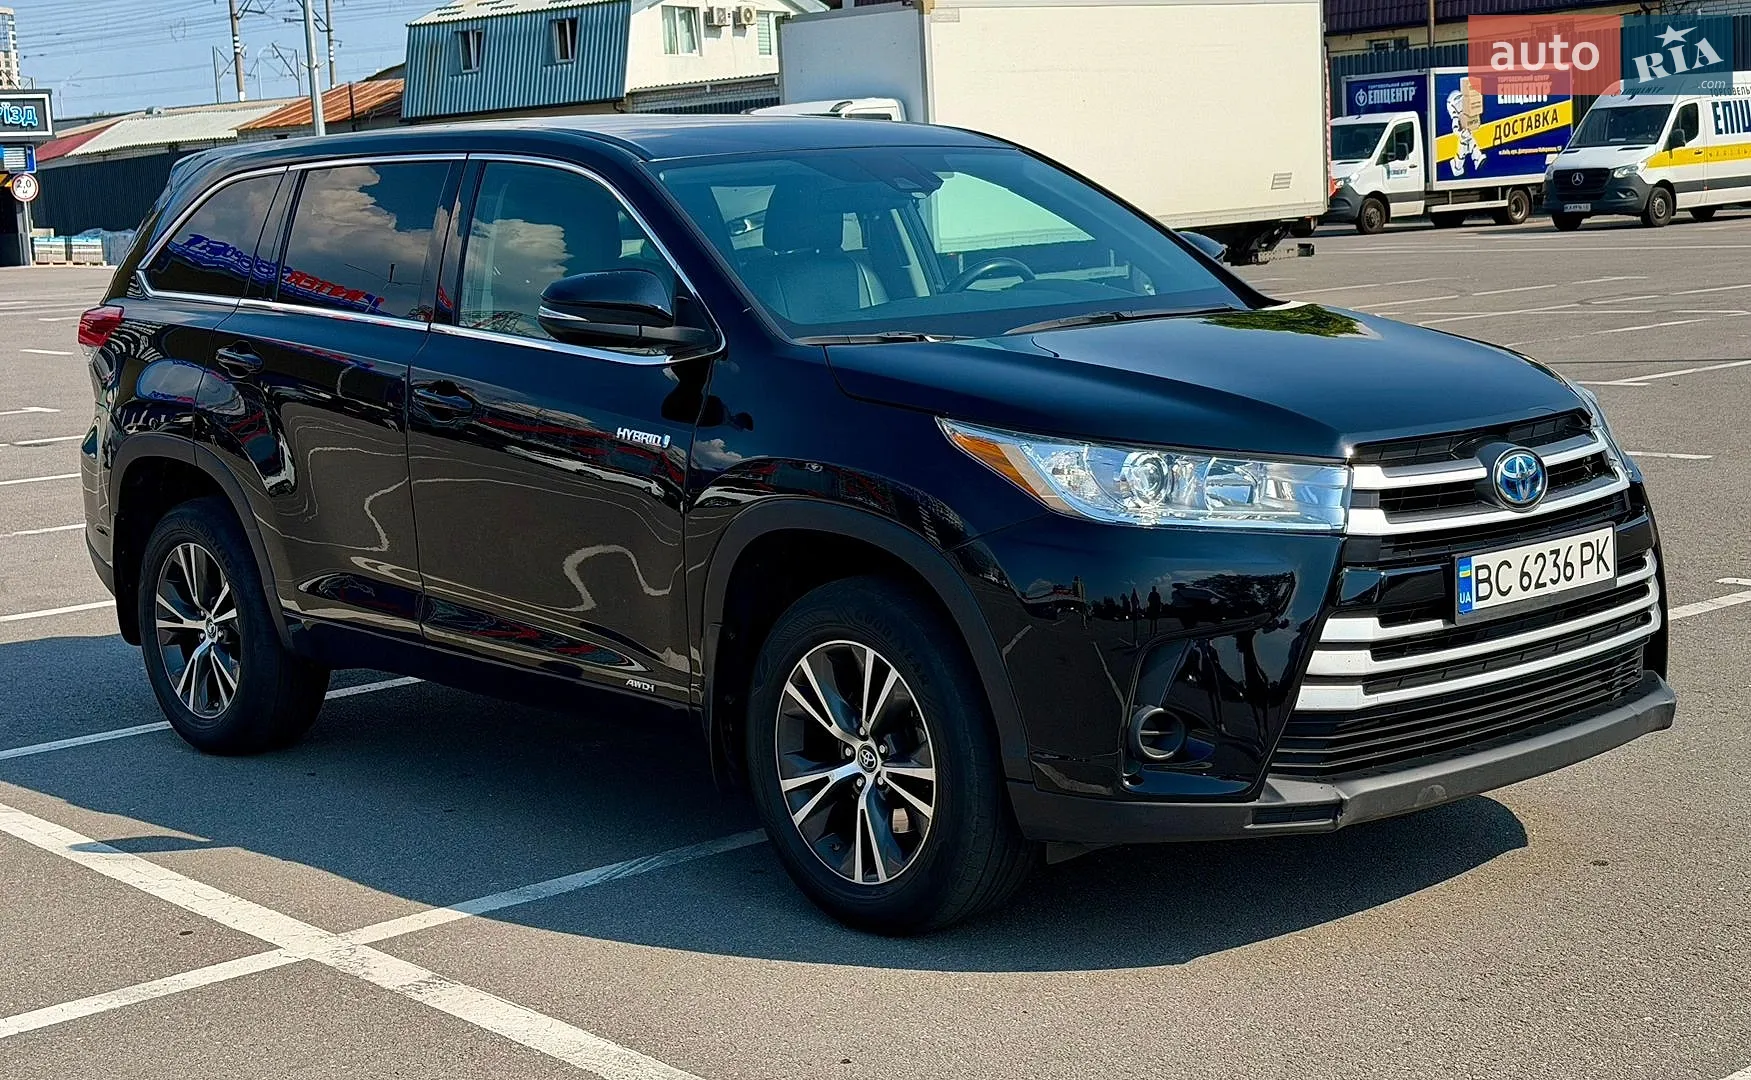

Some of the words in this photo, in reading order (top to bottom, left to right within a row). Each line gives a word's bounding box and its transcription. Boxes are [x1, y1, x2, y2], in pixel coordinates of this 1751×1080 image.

[1710, 86, 1751, 97] ТОРГОВЕЛЬ
[1493, 108, 1559, 146] ДОСТАВКА
[616, 427, 662, 447] HYBRID
[1475, 560, 1513, 602] BC
[1519, 545, 1574, 592] 6236
[1580, 536, 1611, 579] PK
[1459, 592, 1472, 604] UA
